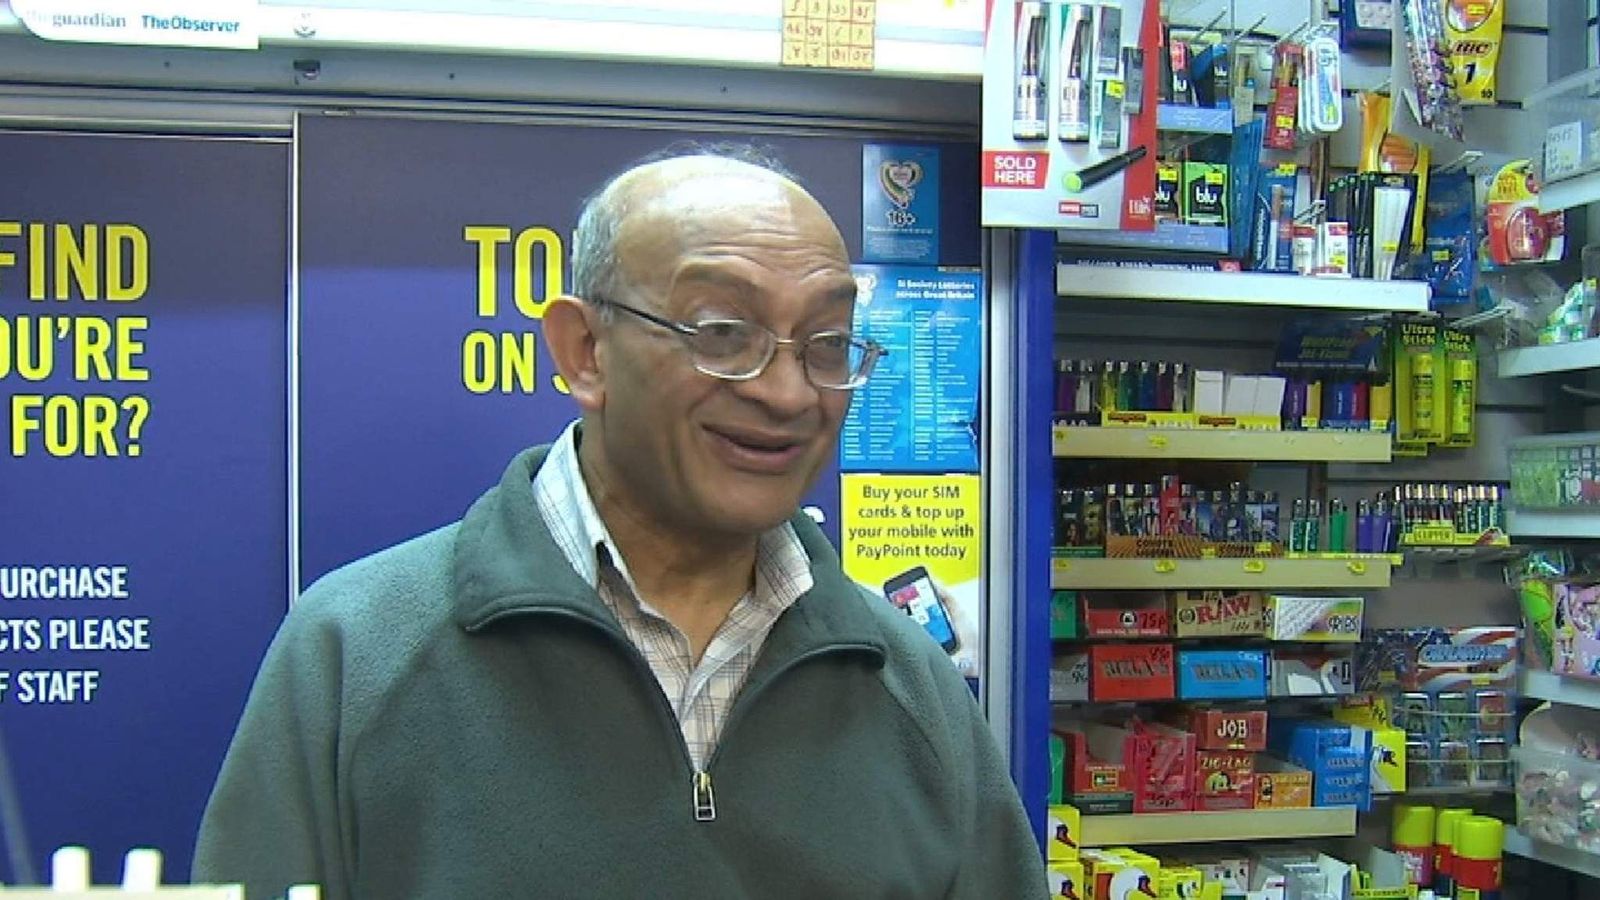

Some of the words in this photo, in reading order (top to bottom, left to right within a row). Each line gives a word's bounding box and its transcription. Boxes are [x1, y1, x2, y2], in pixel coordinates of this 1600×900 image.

[1464, 63, 1477, 85] 1
[993, 155, 1037, 170] SOLD
[993, 170, 1037, 185] HERE
[1195, 185, 1217, 203] blu
[464, 226, 563, 319] TO
[923, 290, 946, 299] Great
[463, 331, 535, 394] ON
[11, 395, 149, 457] FOR?
[862, 485, 890, 501] Buy
[894, 487, 929, 502] your
[932, 486, 960, 499] SIM
[858, 506, 898, 519] cards
[901, 505, 912, 519] &
[916, 507, 942, 521] top
[945, 509, 964, 522] up
[848, 527, 882, 541] your
[887, 525, 937, 539] mobile
[941, 525, 974, 538] with
[856, 544, 920, 560] PayPoint
[924, 544, 966, 560] today
[1195, 594, 1251, 624] RAW
[50, 619, 151, 650] PLEASE
[17, 671, 99, 703] STAFF
[1216, 719, 1247, 738] JOB
